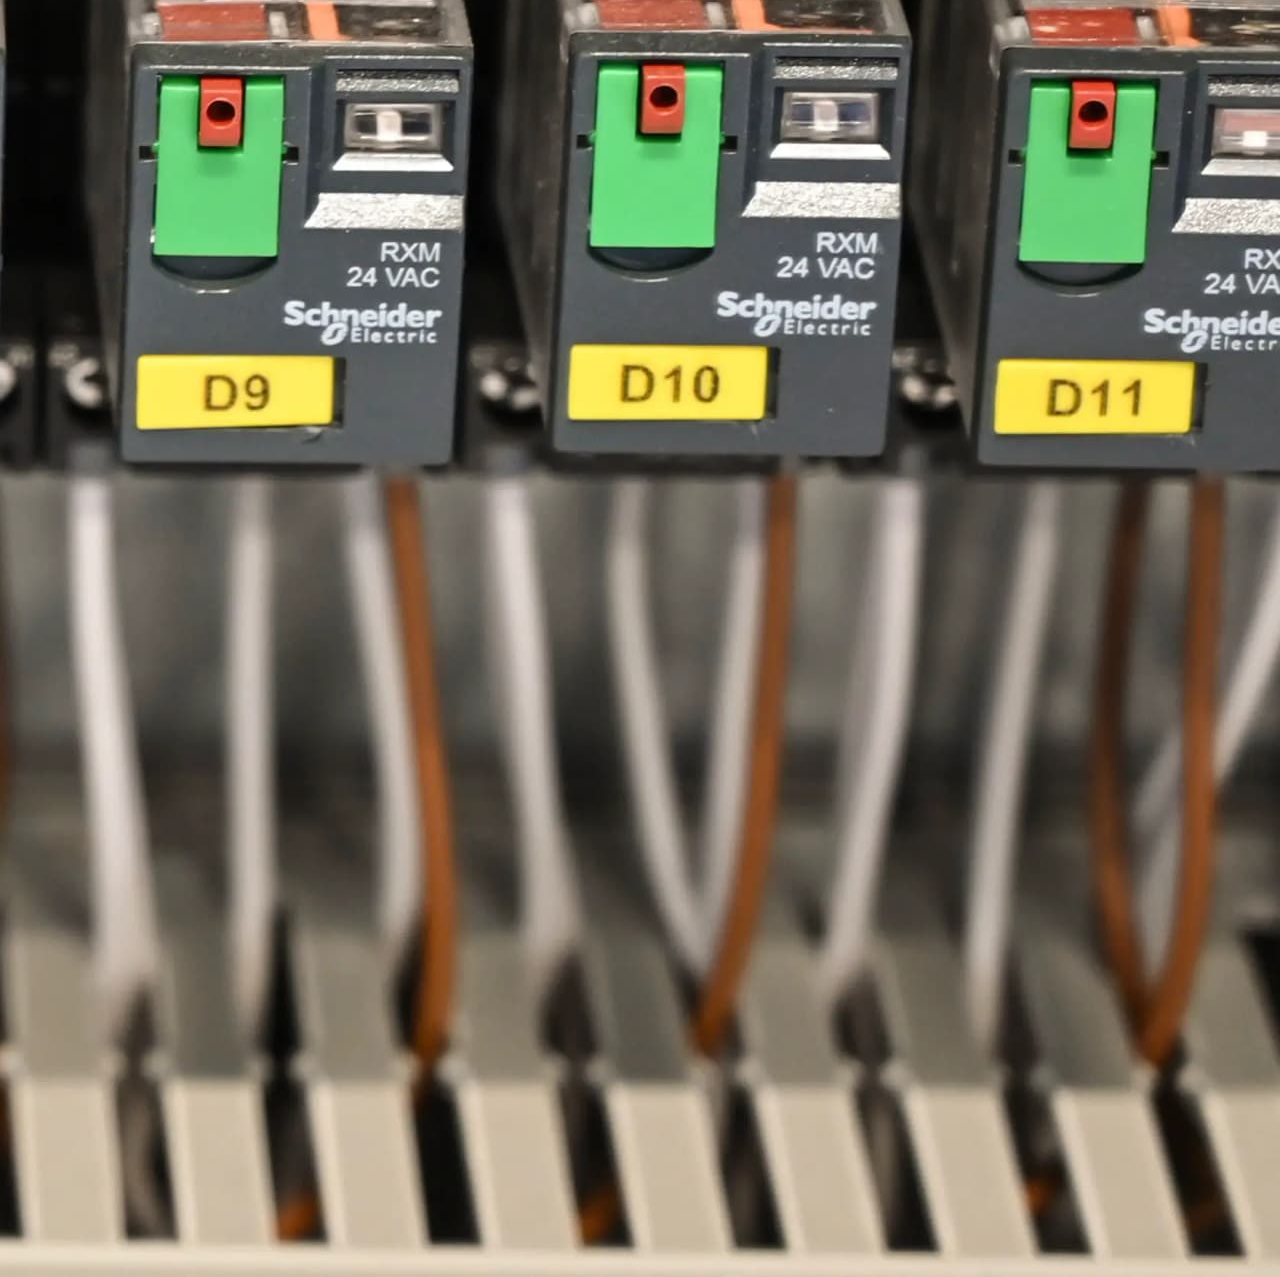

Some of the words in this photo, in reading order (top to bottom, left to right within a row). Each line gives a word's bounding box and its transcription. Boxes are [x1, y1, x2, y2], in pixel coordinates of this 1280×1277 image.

[381, 242, 440, 262] RXM
[817, 232, 877, 254] RXM
[777, 256, 809, 277] 24
[817, 257, 874, 279] VAC
[1244, 248, 1280, 269] RX
[347, 266, 377, 287] 24
[385, 267, 439, 288] VAC
[1204, 273, 1236, 294] 24
[1245, 274, 1280, 294] VA
[284, 301, 442, 327] Schneider
[717, 291, 877, 318] Schneider
[784, 316, 870, 335] Electric
[1144, 308, 1280, 335] Schneide
[351, 325, 436, 343] Electric
[1211, 333, 1279, 350] Electr
[204, 374, 270, 411] D9
[621, 365, 720, 403] D10
[1047, 379, 1141, 416] D11
